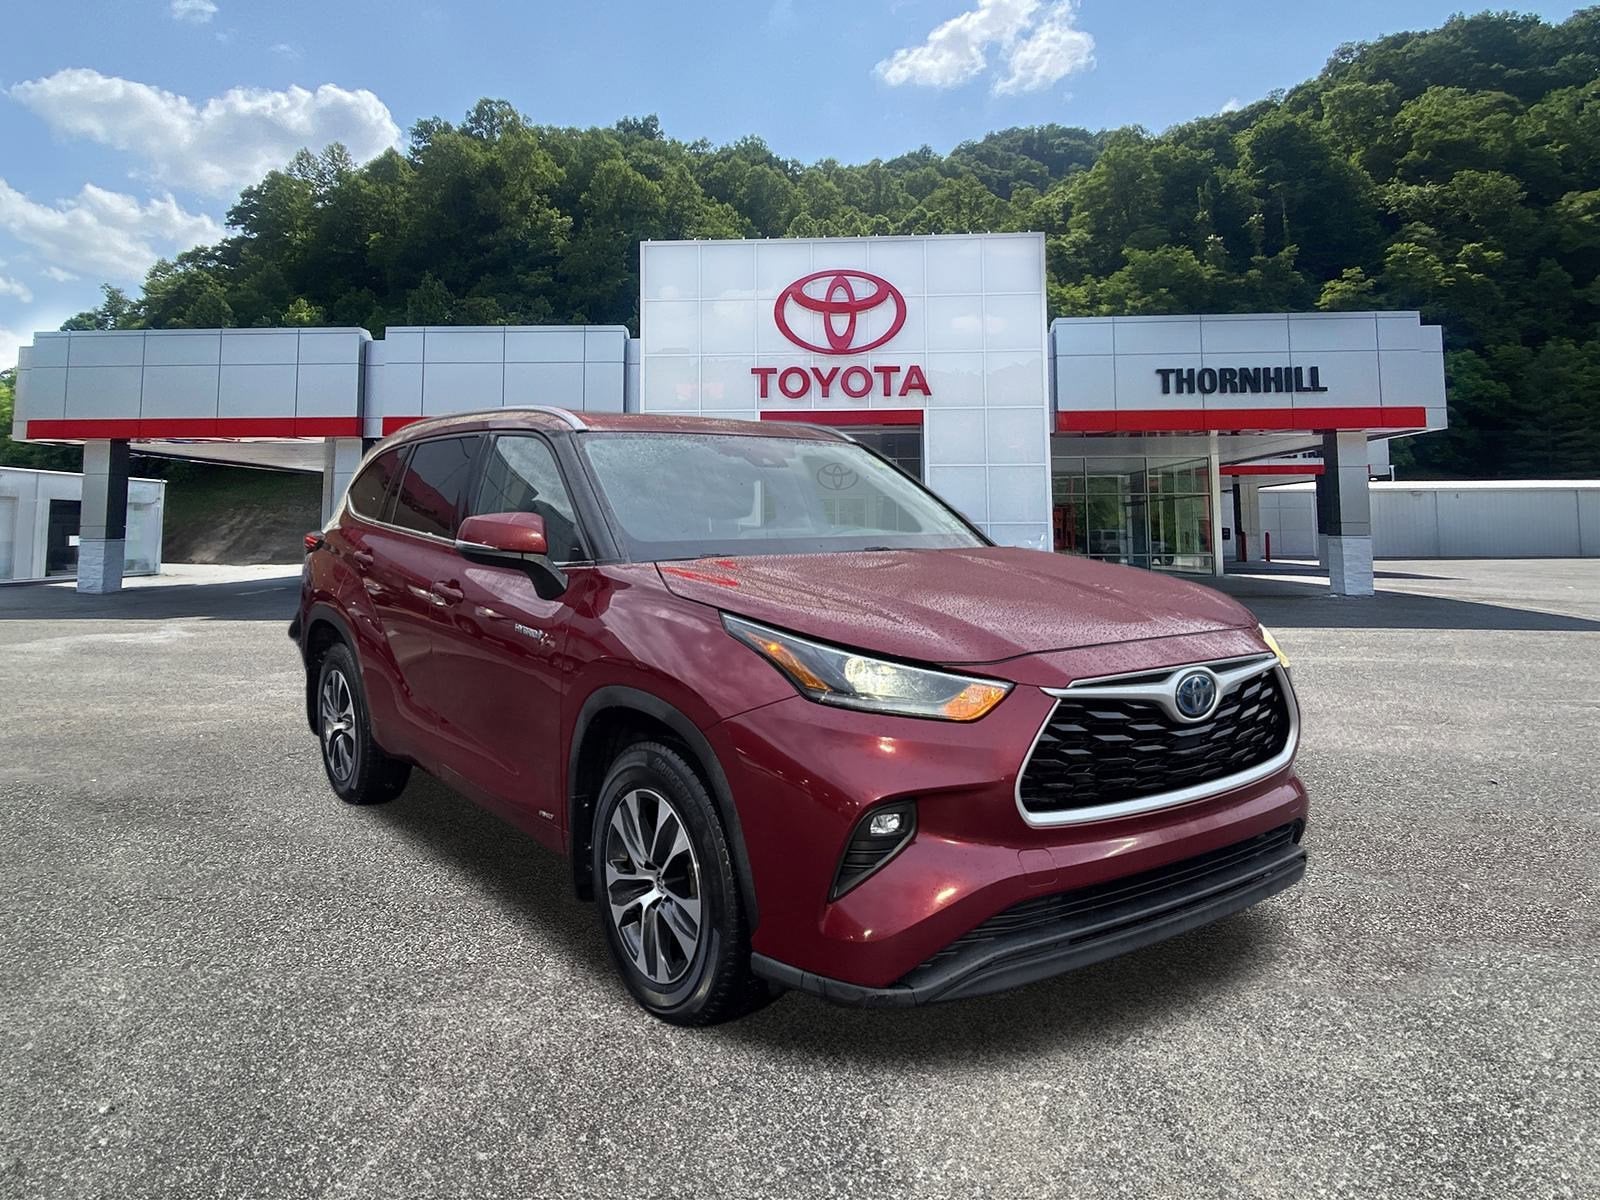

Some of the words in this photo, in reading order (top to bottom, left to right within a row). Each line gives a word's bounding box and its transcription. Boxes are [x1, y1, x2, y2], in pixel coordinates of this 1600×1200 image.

[751, 365, 932, 399] TOYOTA
[1156, 366, 1328, 395] THORNHILL
[514, 623, 544, 640] HYBRID
